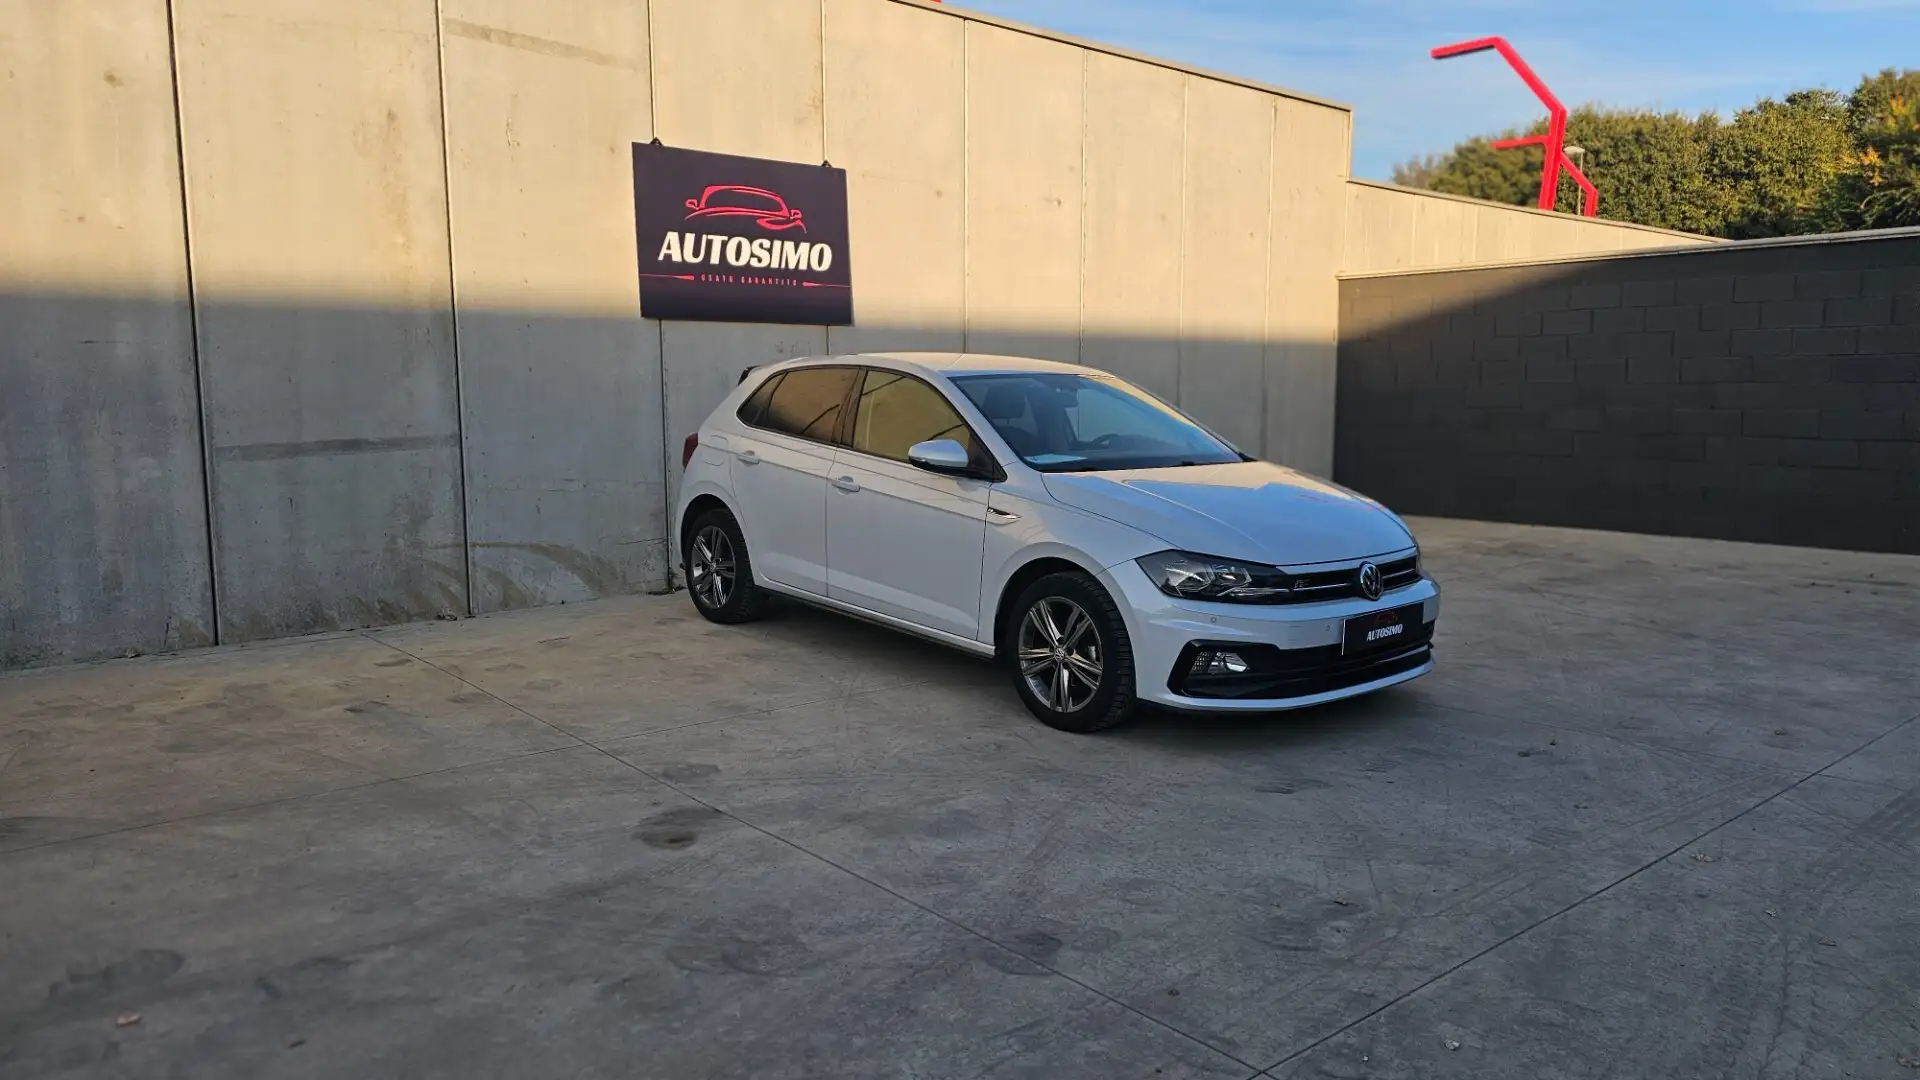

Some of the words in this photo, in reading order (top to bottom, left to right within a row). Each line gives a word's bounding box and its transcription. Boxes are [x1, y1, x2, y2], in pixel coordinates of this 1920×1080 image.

[658, 231, 832, 272] AUTOSIMO
[701, 273, 733, 283] USATO
[1366, 623, 1403, 642] AUTOSIMO
